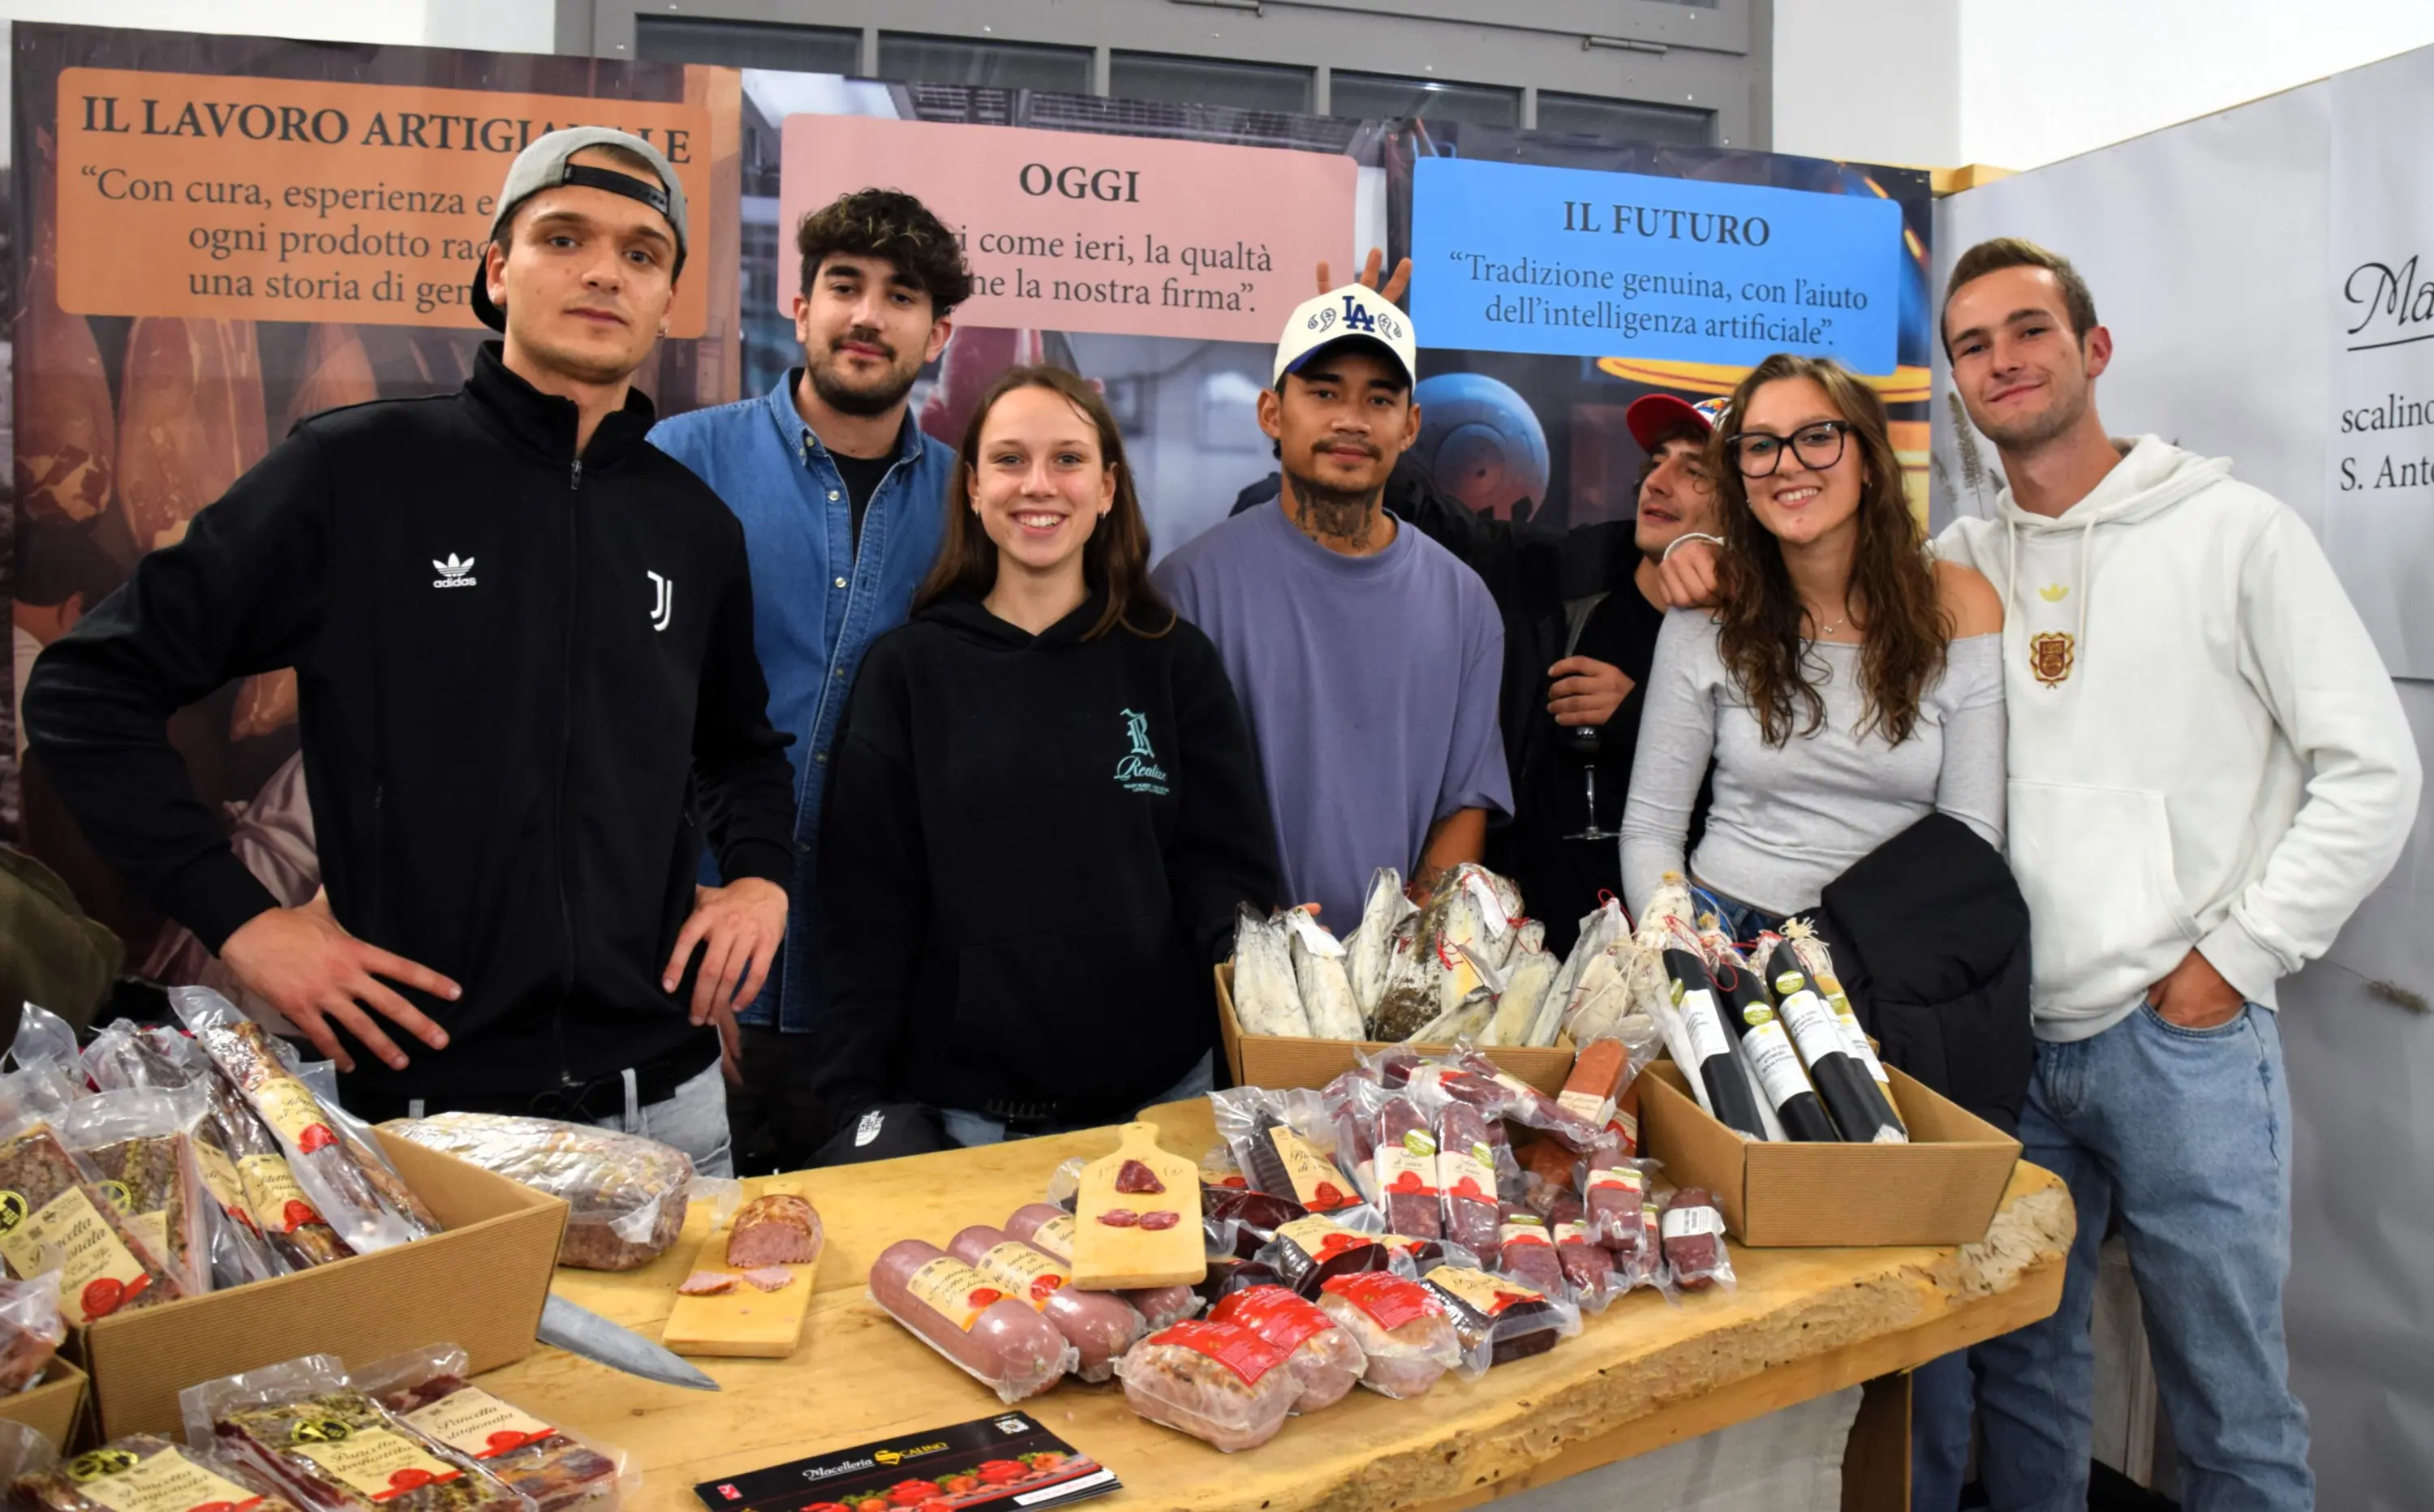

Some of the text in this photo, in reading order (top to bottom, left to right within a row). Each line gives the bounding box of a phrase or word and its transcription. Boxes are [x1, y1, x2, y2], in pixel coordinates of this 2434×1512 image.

[81, 96, 691, 164] IL LAVORO ARTIGIE
[81, 165, 493, 219] “Con cura, esperienza e
[1019, 163, 1140, 203] OGGI
[189, 223, 268, 260] ogni
[278, 225, 430, 262] prodotto
[1563, 201, 1770, 246] IL FUTURO
[978, 232, 1065, 258] come
[1075, 232, 1134, 266] ieri,
[1144, 234, 1171, 264] la
[1180, 242, 1273, 276] qualtà
[189, 270, 474, 315] una storia di gen
[1015, 268, 1042, 299] la
[1052, 278, 1151, 305] nostra
[1450, 251, 1615, 289] “Tradizione
[1623, 272, 1732, 303] genuina,
[1741, 281, 1787, 303] con
[1342, 295, 1375, 333] LA
[2340, 454, 2434, 492] S. Ant
[432, 577, 477, 588] adidas
[802, 1458, 874, 1480] Macelleria
